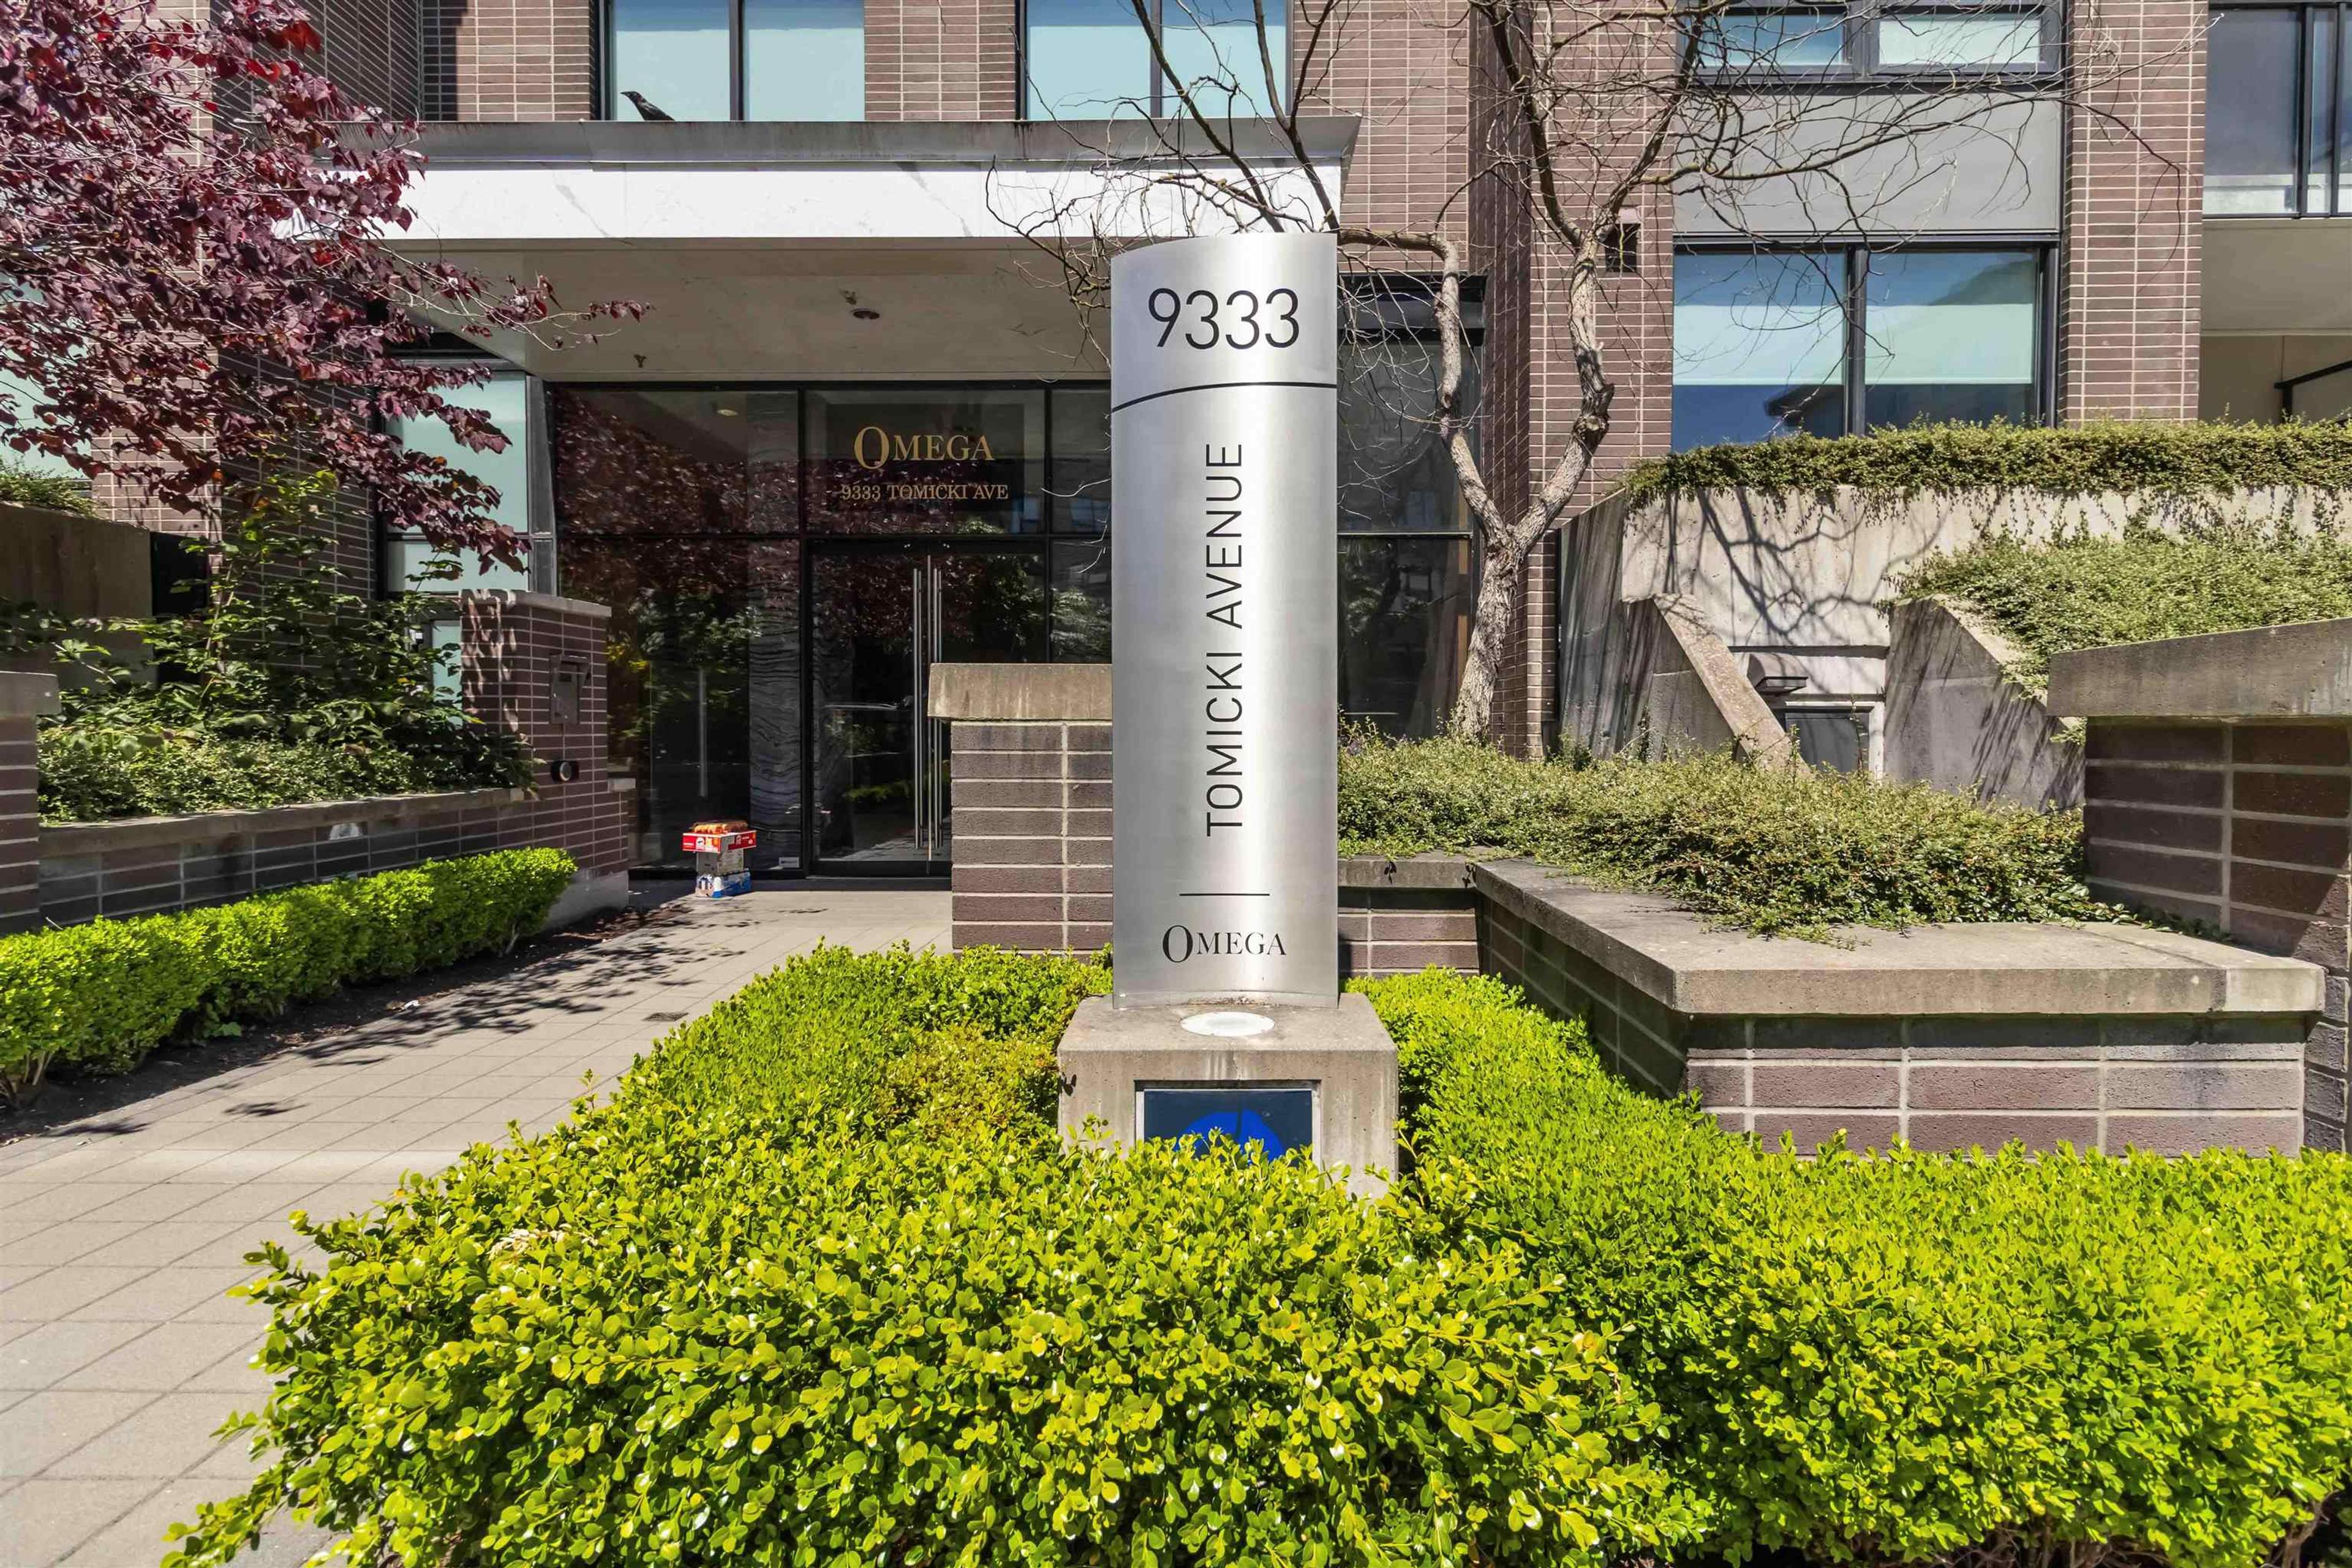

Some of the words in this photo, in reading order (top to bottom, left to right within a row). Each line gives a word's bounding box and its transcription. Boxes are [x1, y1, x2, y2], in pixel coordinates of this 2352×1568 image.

[1148, 287, 1300, 350] 9333
[854, 426, 995, 470] OMEGA
[842, 484, 881, 500] 9333
[887, 484, 967, 500] TOMICKI
[974, 484, 1009, 499] AVE
[1205, 444, 1243, 630] AVENUE
[1205, 652, 1243, 837] TOMICKI
[1163, 925, 1286, 963] OMEGA
